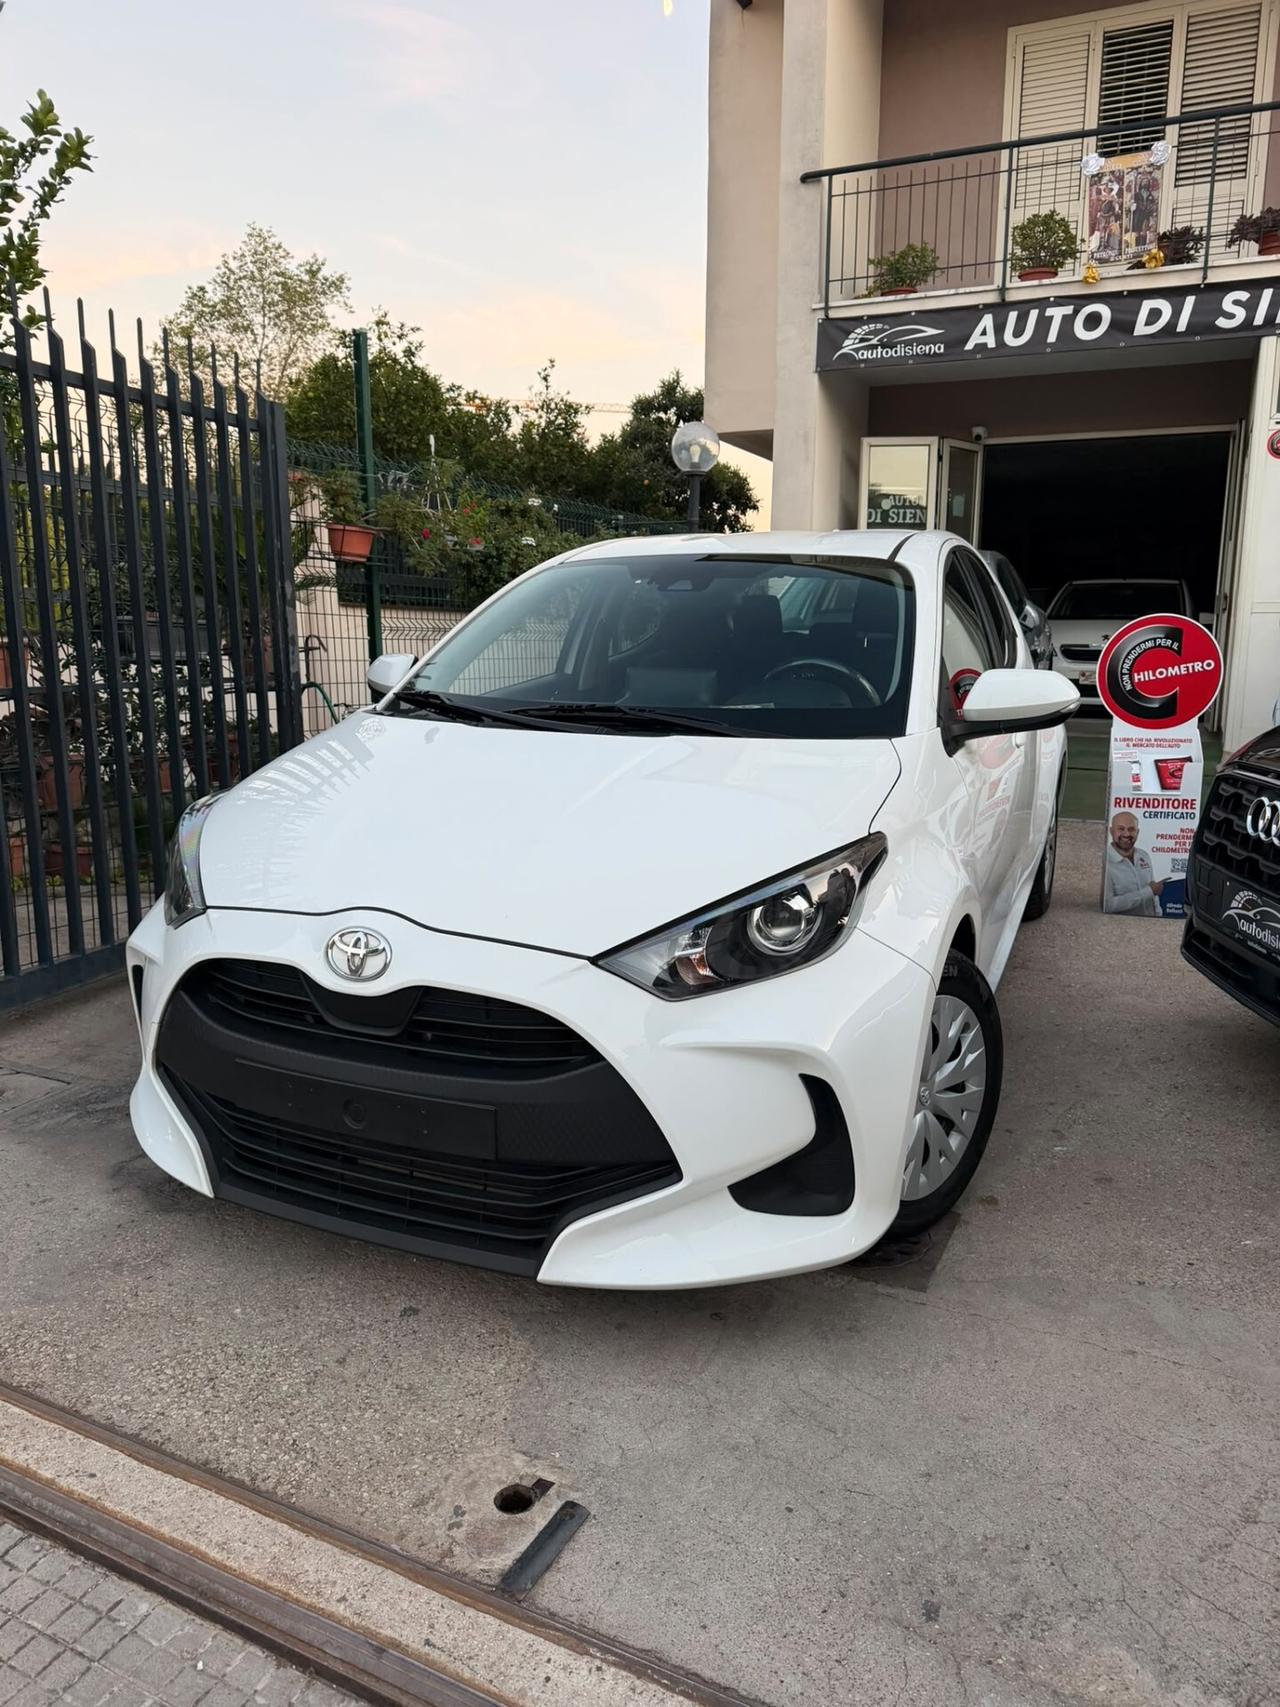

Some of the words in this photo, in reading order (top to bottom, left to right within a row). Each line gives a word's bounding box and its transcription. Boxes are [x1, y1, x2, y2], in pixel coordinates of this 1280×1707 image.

[963, 303, 1112, 350] AUTO
[1133, 295, 1197, 336] DI
[1214, 288, 1280, 329] SI
[858, 342, 945, 360] autodisiena
[1155, 638, 1173, 648] PER
[1171, 641, 1179, 650] IL
[1121, 640, 1155, 674] PRENDERMI
[1121, 674, 1133, 691] NON
[1114, 797, 1197, 810] RIVENDITORE
[1142, 810, 1196, 820] CERTIFICATO
[1240, 919, 1280, 950] autodisi
